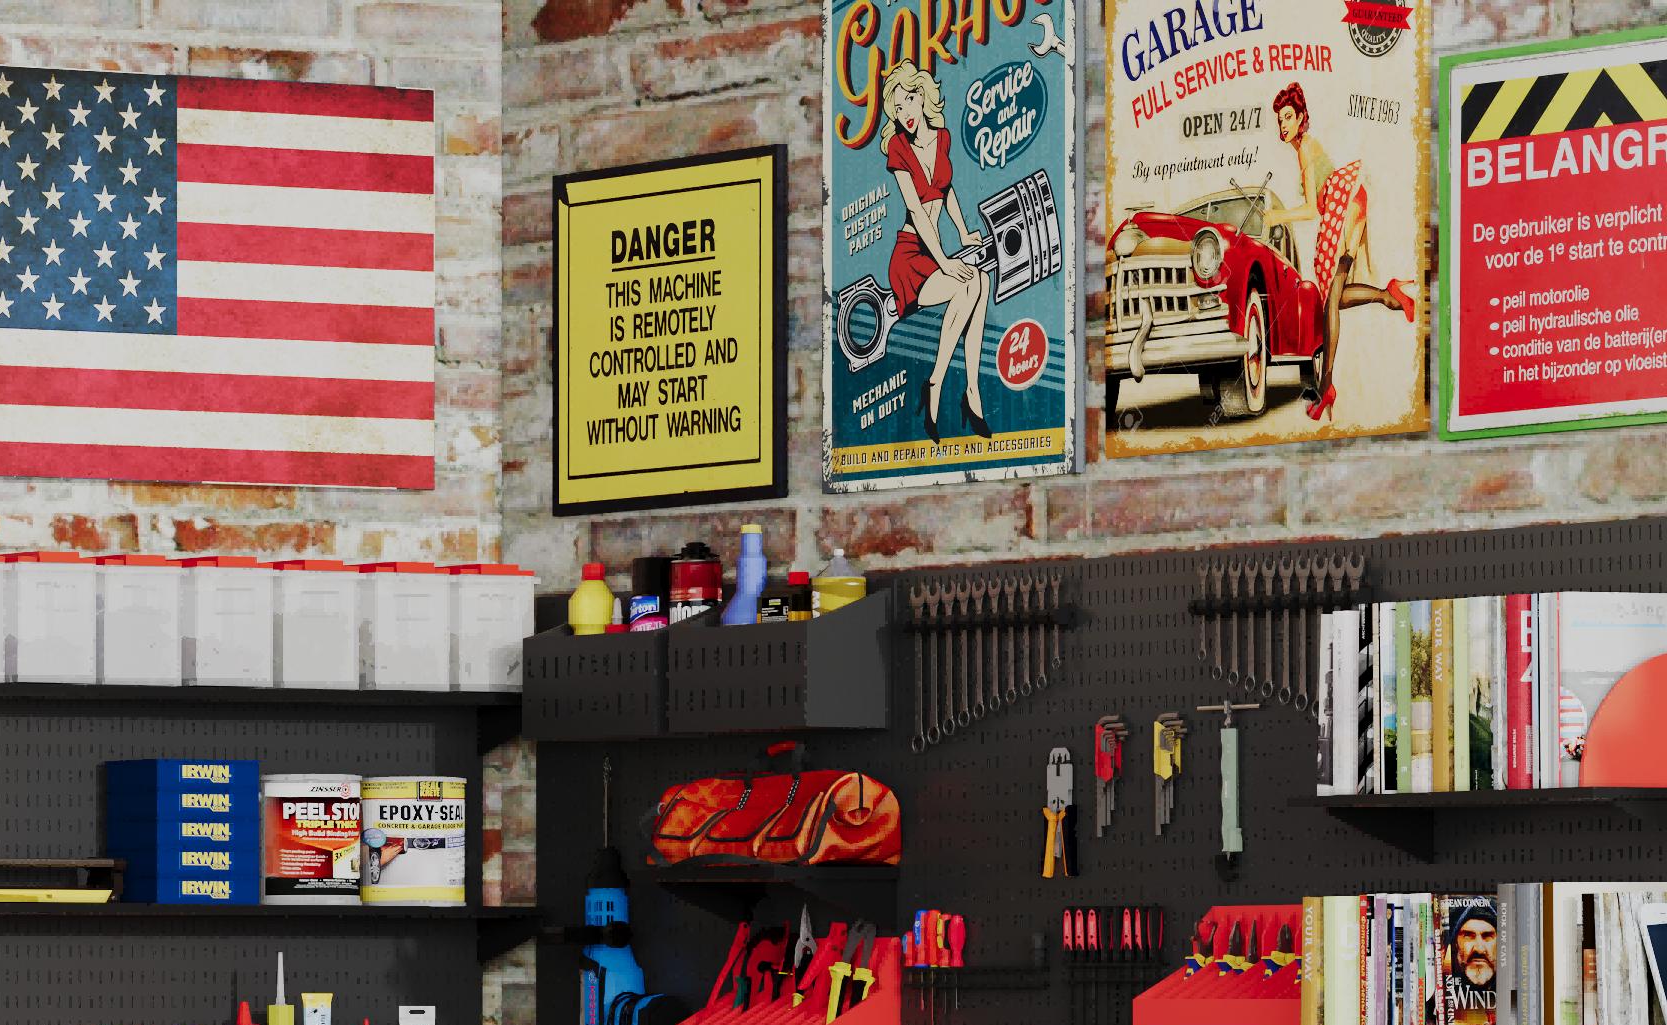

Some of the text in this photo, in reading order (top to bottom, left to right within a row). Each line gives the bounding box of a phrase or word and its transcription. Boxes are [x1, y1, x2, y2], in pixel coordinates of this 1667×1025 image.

[1121, 0, 1264, 82] GARAGE
[1361, 28, 1387, 43] QUALITY
[966, 60, 1035, 127] Service
[1132, 44, 1333, 128] FULL SERVICE & REPAIR
[997, 100, 1018, 125] and
[1183, 107, 1262, 138] OPEN 24/7
[1348, 94, 1401, 125] SINCE 1963
[974, 106, 1036, 170] Repair
[1132, 146, 1259, 180] By appointment only!
[841, 184, 891, 222] ORIGINAL
[844, 204, 888, 240] CUSTOM
[1473, 204, 1662, 245] De gebruiker is verplicht
[611, 218, 715, 264] DANGER
[849, 225, 883, 256] PARTS
[1485, 236, 1624, 270] voor de start te
[606, 270, 722, 308] THIS MACHINE
[1503, 285, 1590, 314] peil motorolie
[610, 305, 716, 342] IS REMOTELY
[1503, 304, 1639, 338] peil hydraulische olie
[1009, 326, 1030, 354] 24
[1503, 333, 1601, 359] conditie van de
[589, 337, 738, 378] CONTROLLED AND
[1008, 352, 1039, 379] hours
[1503, 366, 1515, 384] in
[1518, 363, 1539, 382] het
[1542, 359, 1601, 383] bijzonder
[1604, 359, 1622, 376] op
[618, 375, 708, 409] MAY START
[852, 370, 907, 415] MECHANIC
[587, 406, 741, 445] WITHOUT WARNING
[860, 392, 906, 430] ON DUTY
[841, 435, 1052, 467] BUILD AND REPAIR PARTS AND ACCESSORIES
[1434, 607, 1443, 682] YOUR WAY
[182, 765, 229, 779] IRWIN
[182, 794, 229, 808] IRWIN
[283, 803, 330, 820] PEEL
[182, 823, 229, 837] IRWIN
[291, 829, 307, 837] High
[296, 820, 334, 829] TRIPLE
[182, 852, 229, 866] IRWIN
[182, 881, 229, 895] IRWIN
[1462, 899, 1491, 908] CONNERY
[1303, 906, 1313, 983] YOUR WAY
[1501, 930, 1507, 942] OF
[1452, 985, 1496, 1010] WIND
